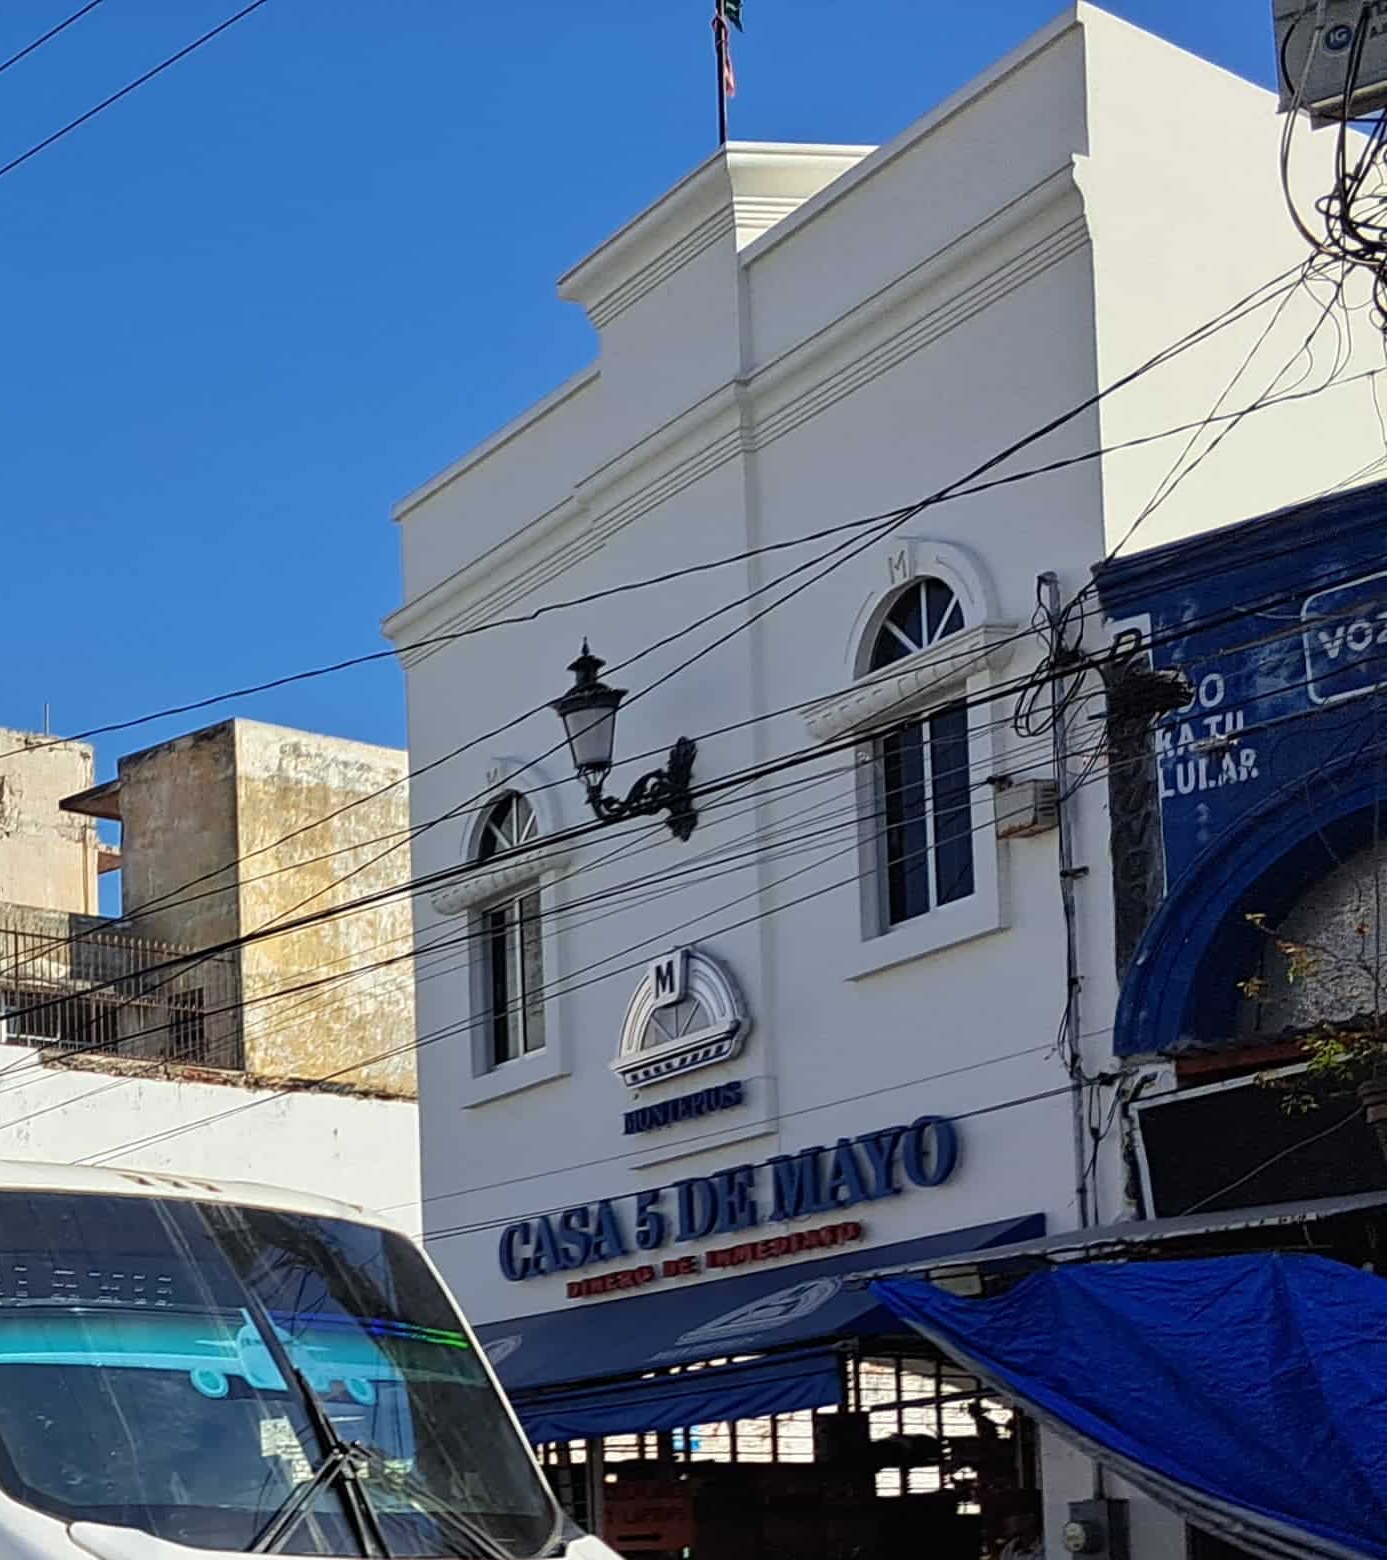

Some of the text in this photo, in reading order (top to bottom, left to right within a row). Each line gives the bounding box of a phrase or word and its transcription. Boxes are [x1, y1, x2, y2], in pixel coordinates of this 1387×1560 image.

[654, 959, 675, 998] M
[498, 1115, 959, 1282] CASA 5 DE MAYO
